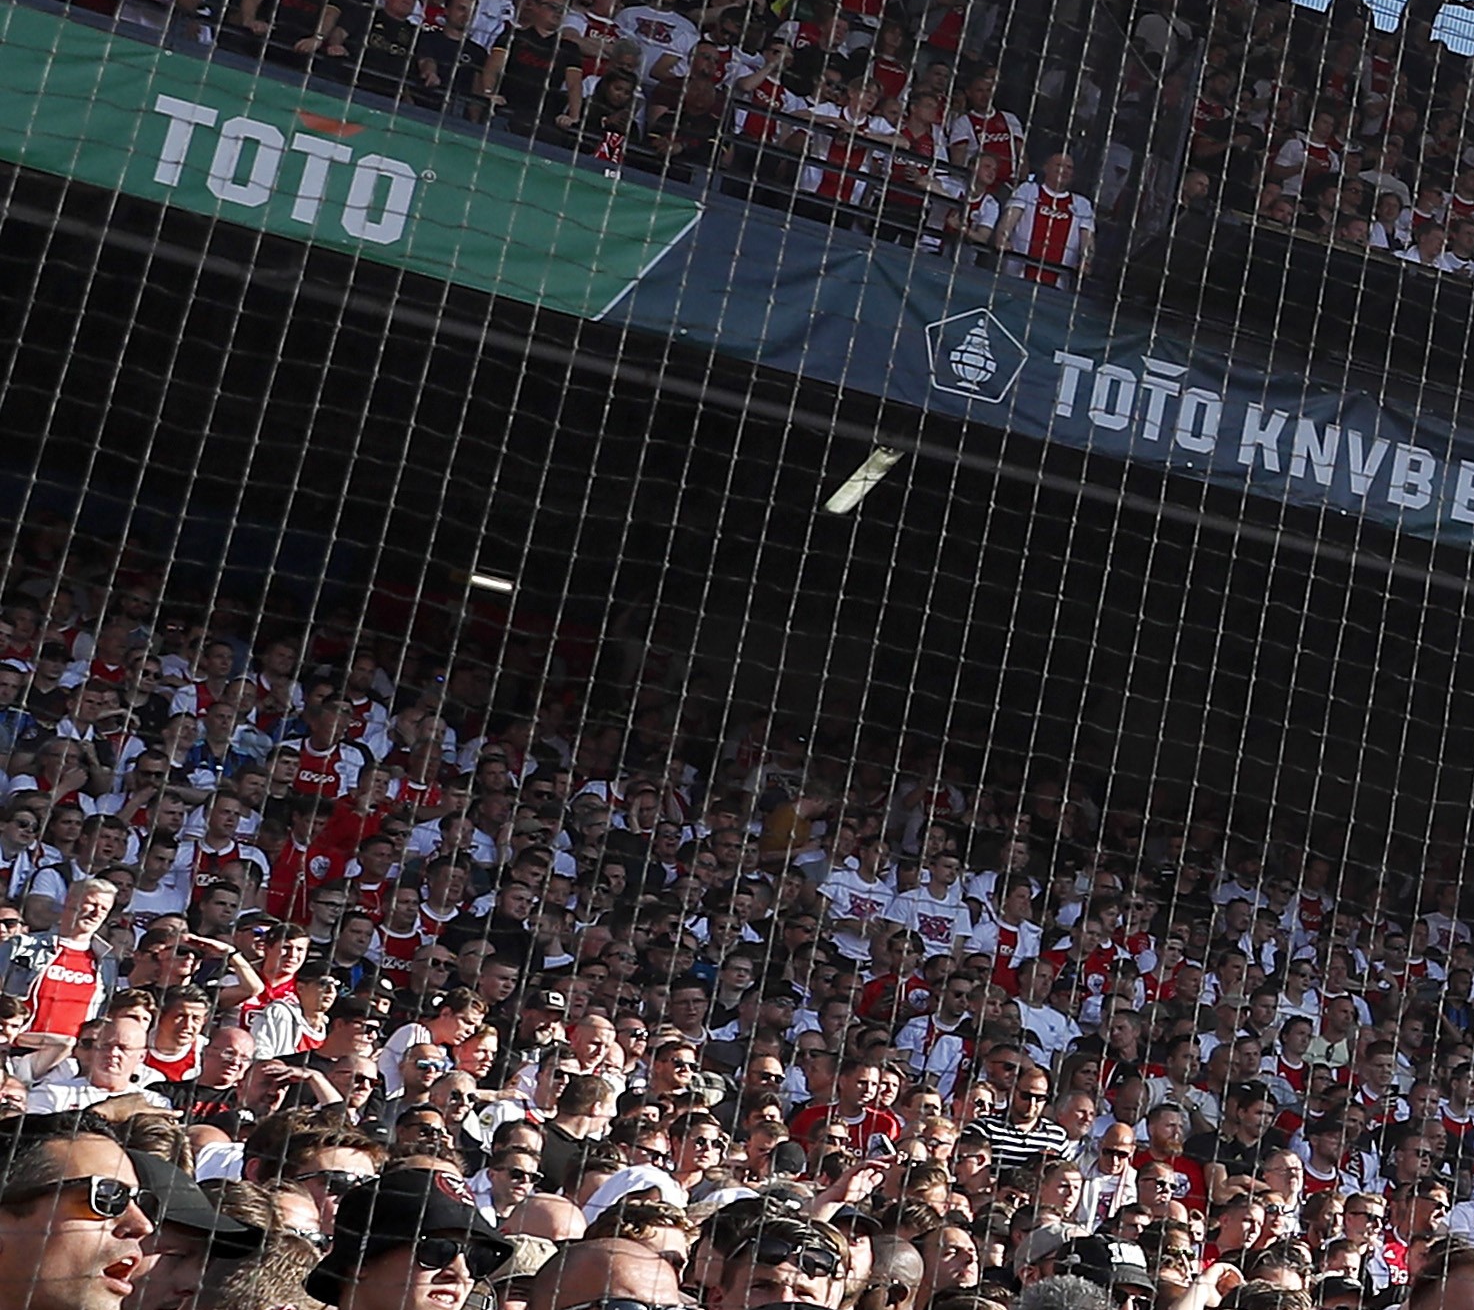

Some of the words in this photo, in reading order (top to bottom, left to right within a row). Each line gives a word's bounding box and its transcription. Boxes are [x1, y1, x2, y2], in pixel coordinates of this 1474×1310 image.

[152, 94, 417, 245] TOTO
[1054, 350, 1224, 453] TOTO
[1238, 402, 1437, 511] KNVB
